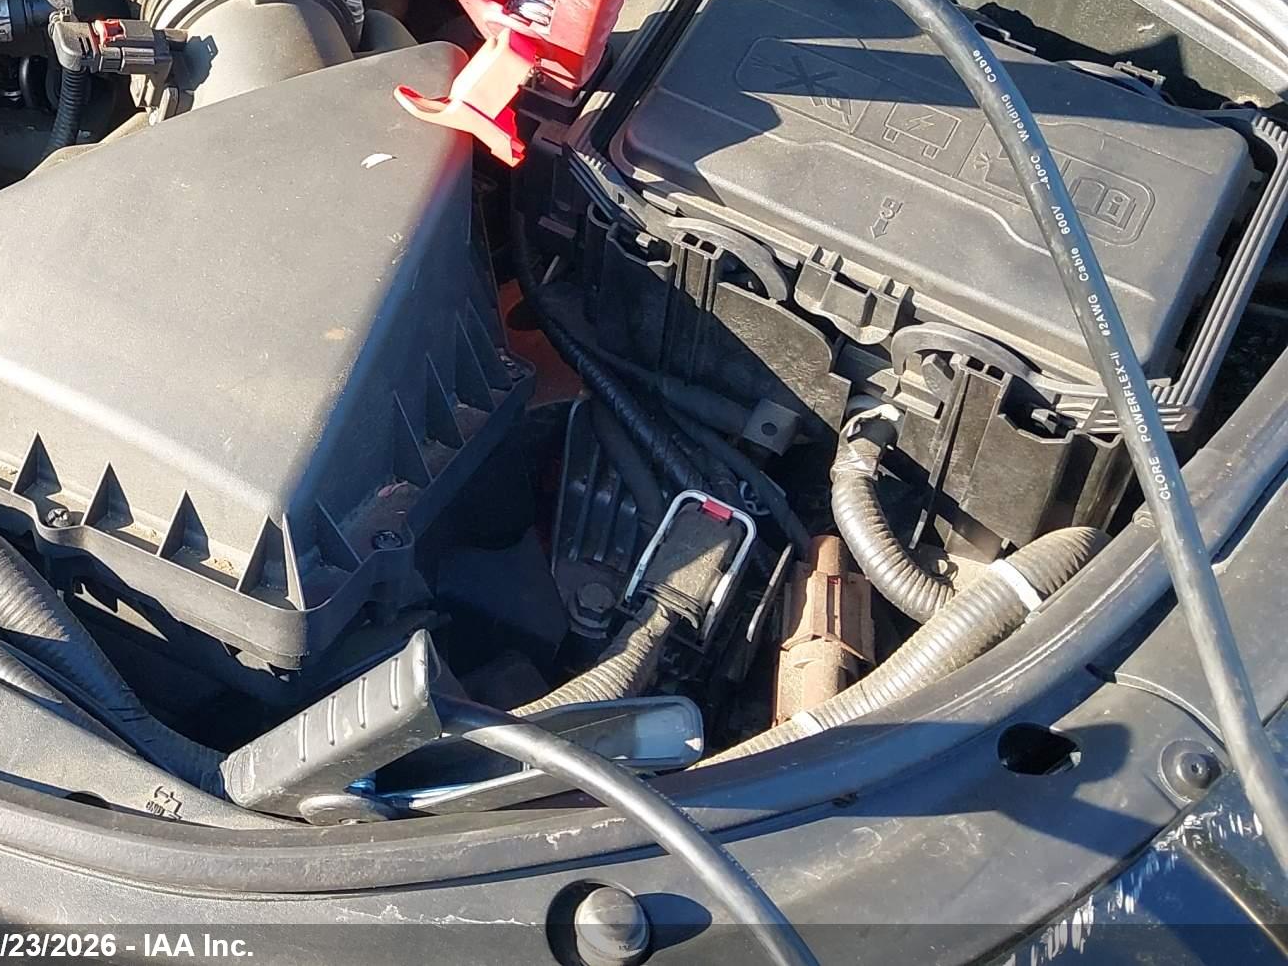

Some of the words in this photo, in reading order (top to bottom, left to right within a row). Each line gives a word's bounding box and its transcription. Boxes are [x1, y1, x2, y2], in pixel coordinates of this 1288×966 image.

[972, 49, 997, 83] Cable
[1001, 94, 1030, 142] Welding
[1051, 205, 1070, 235] 600V
[1071, 247, 1089, 282] Cable
[1108, 351, 1152, 443] POWERFLEX-II
[1148, 456, 1171, 500] CLORE
